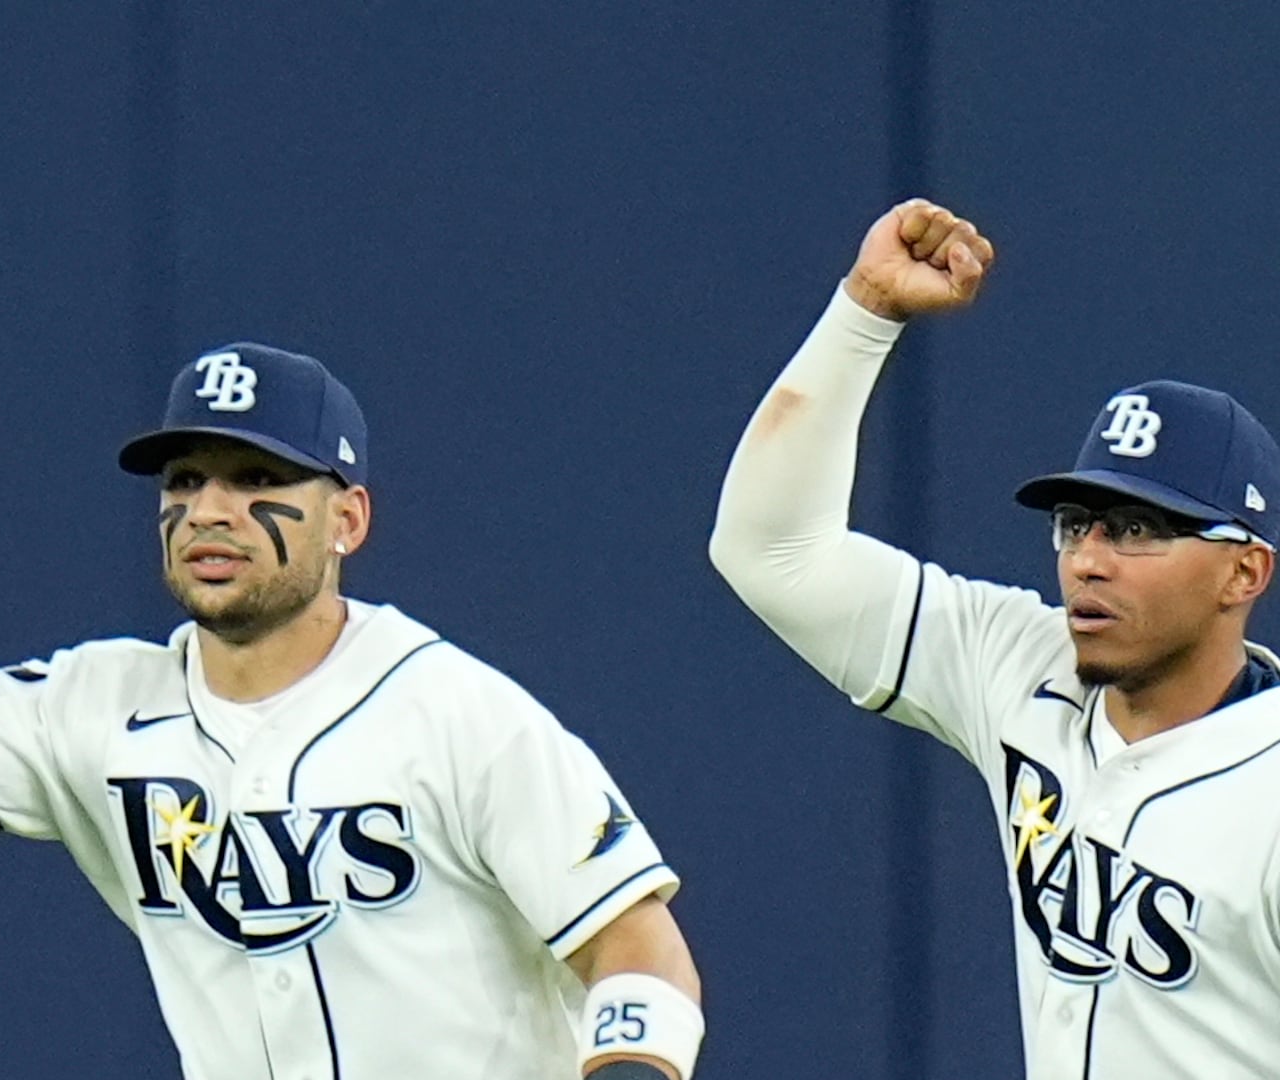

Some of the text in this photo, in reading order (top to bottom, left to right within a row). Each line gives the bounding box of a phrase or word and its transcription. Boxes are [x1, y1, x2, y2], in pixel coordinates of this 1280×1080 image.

[195, 352, 258, 412] TB
[1100, 394, 1162, 458] TB
[106, 776, 422, 956] RAYS
[999, 739, 1203, 991] RAYS
[593, 1002, 648, 1047] 25
